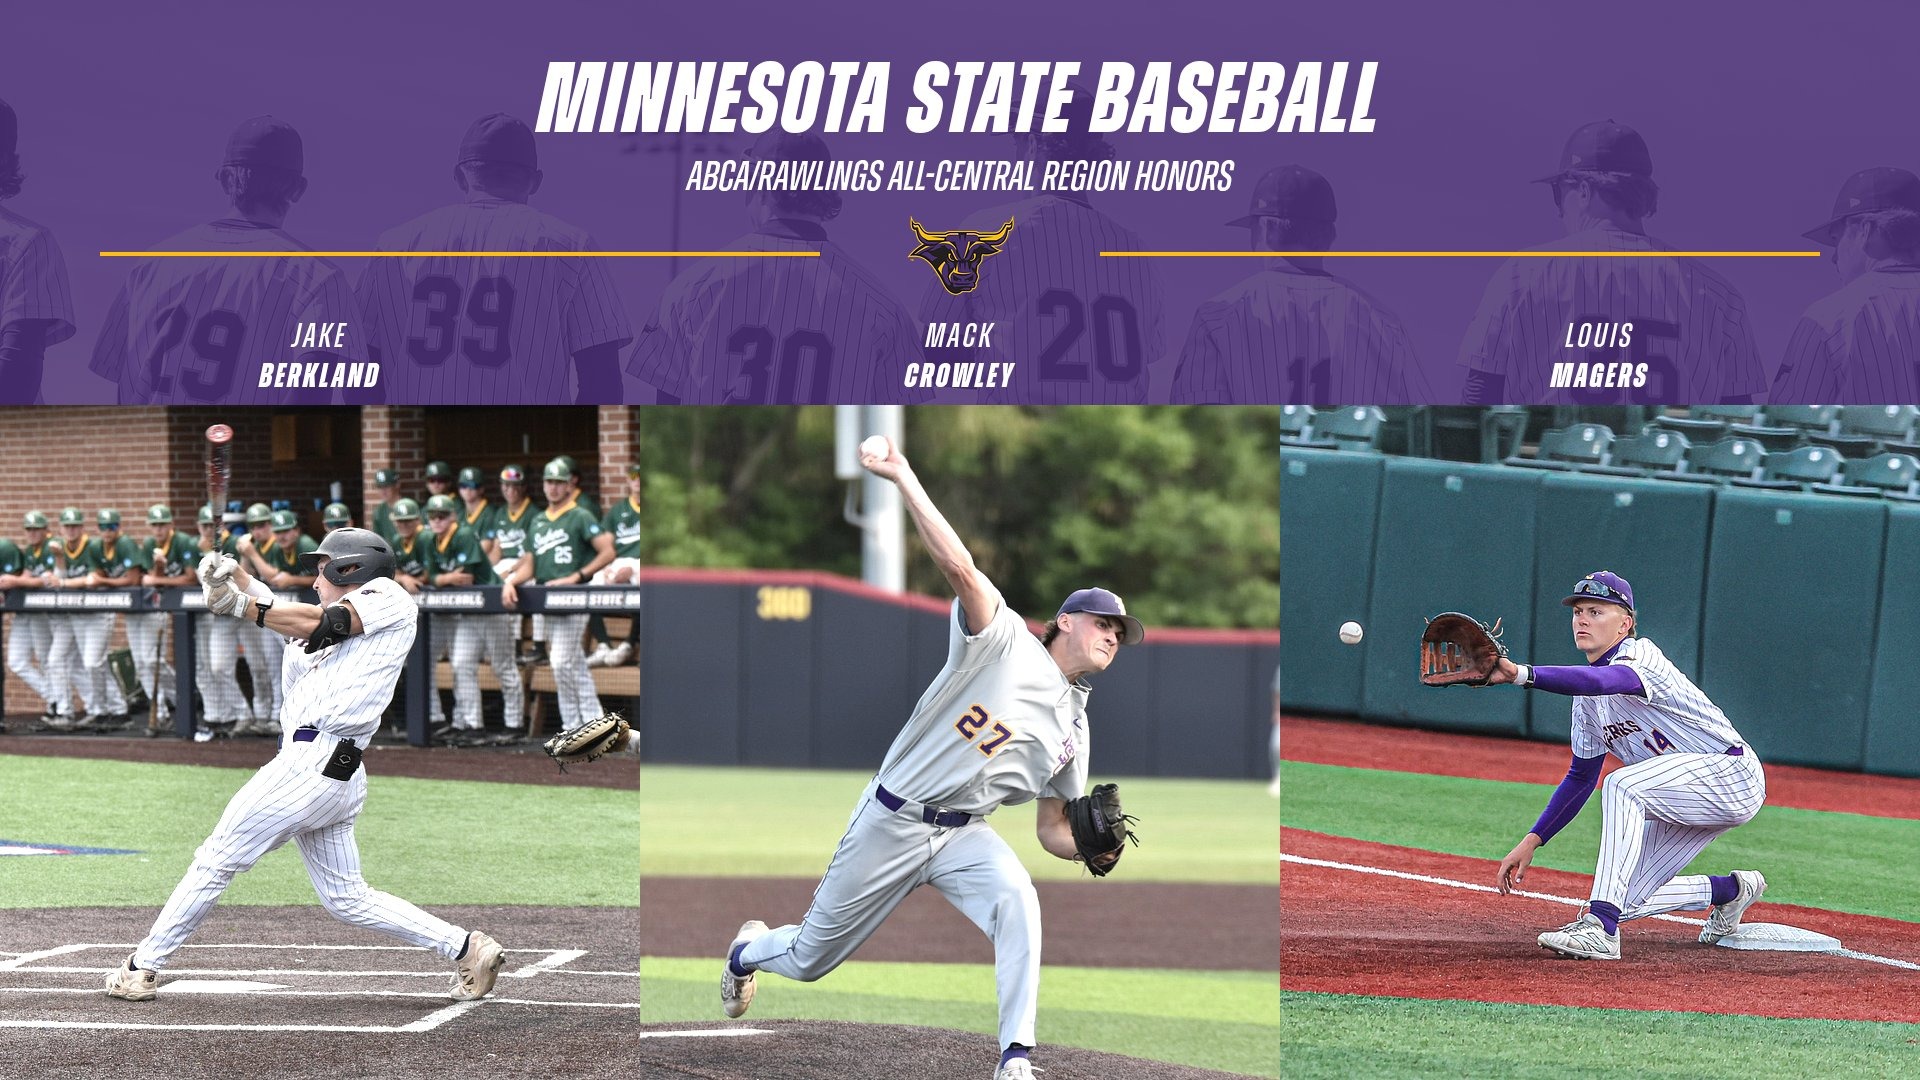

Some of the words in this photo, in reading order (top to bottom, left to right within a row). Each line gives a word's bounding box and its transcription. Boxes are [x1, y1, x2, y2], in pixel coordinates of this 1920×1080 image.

[407, 275, 518, 369] 39
[1037, 287, 1144, 385] 20
[954, 703, 1015, 758] 27
[1643, 726, 1677, 756] 14
